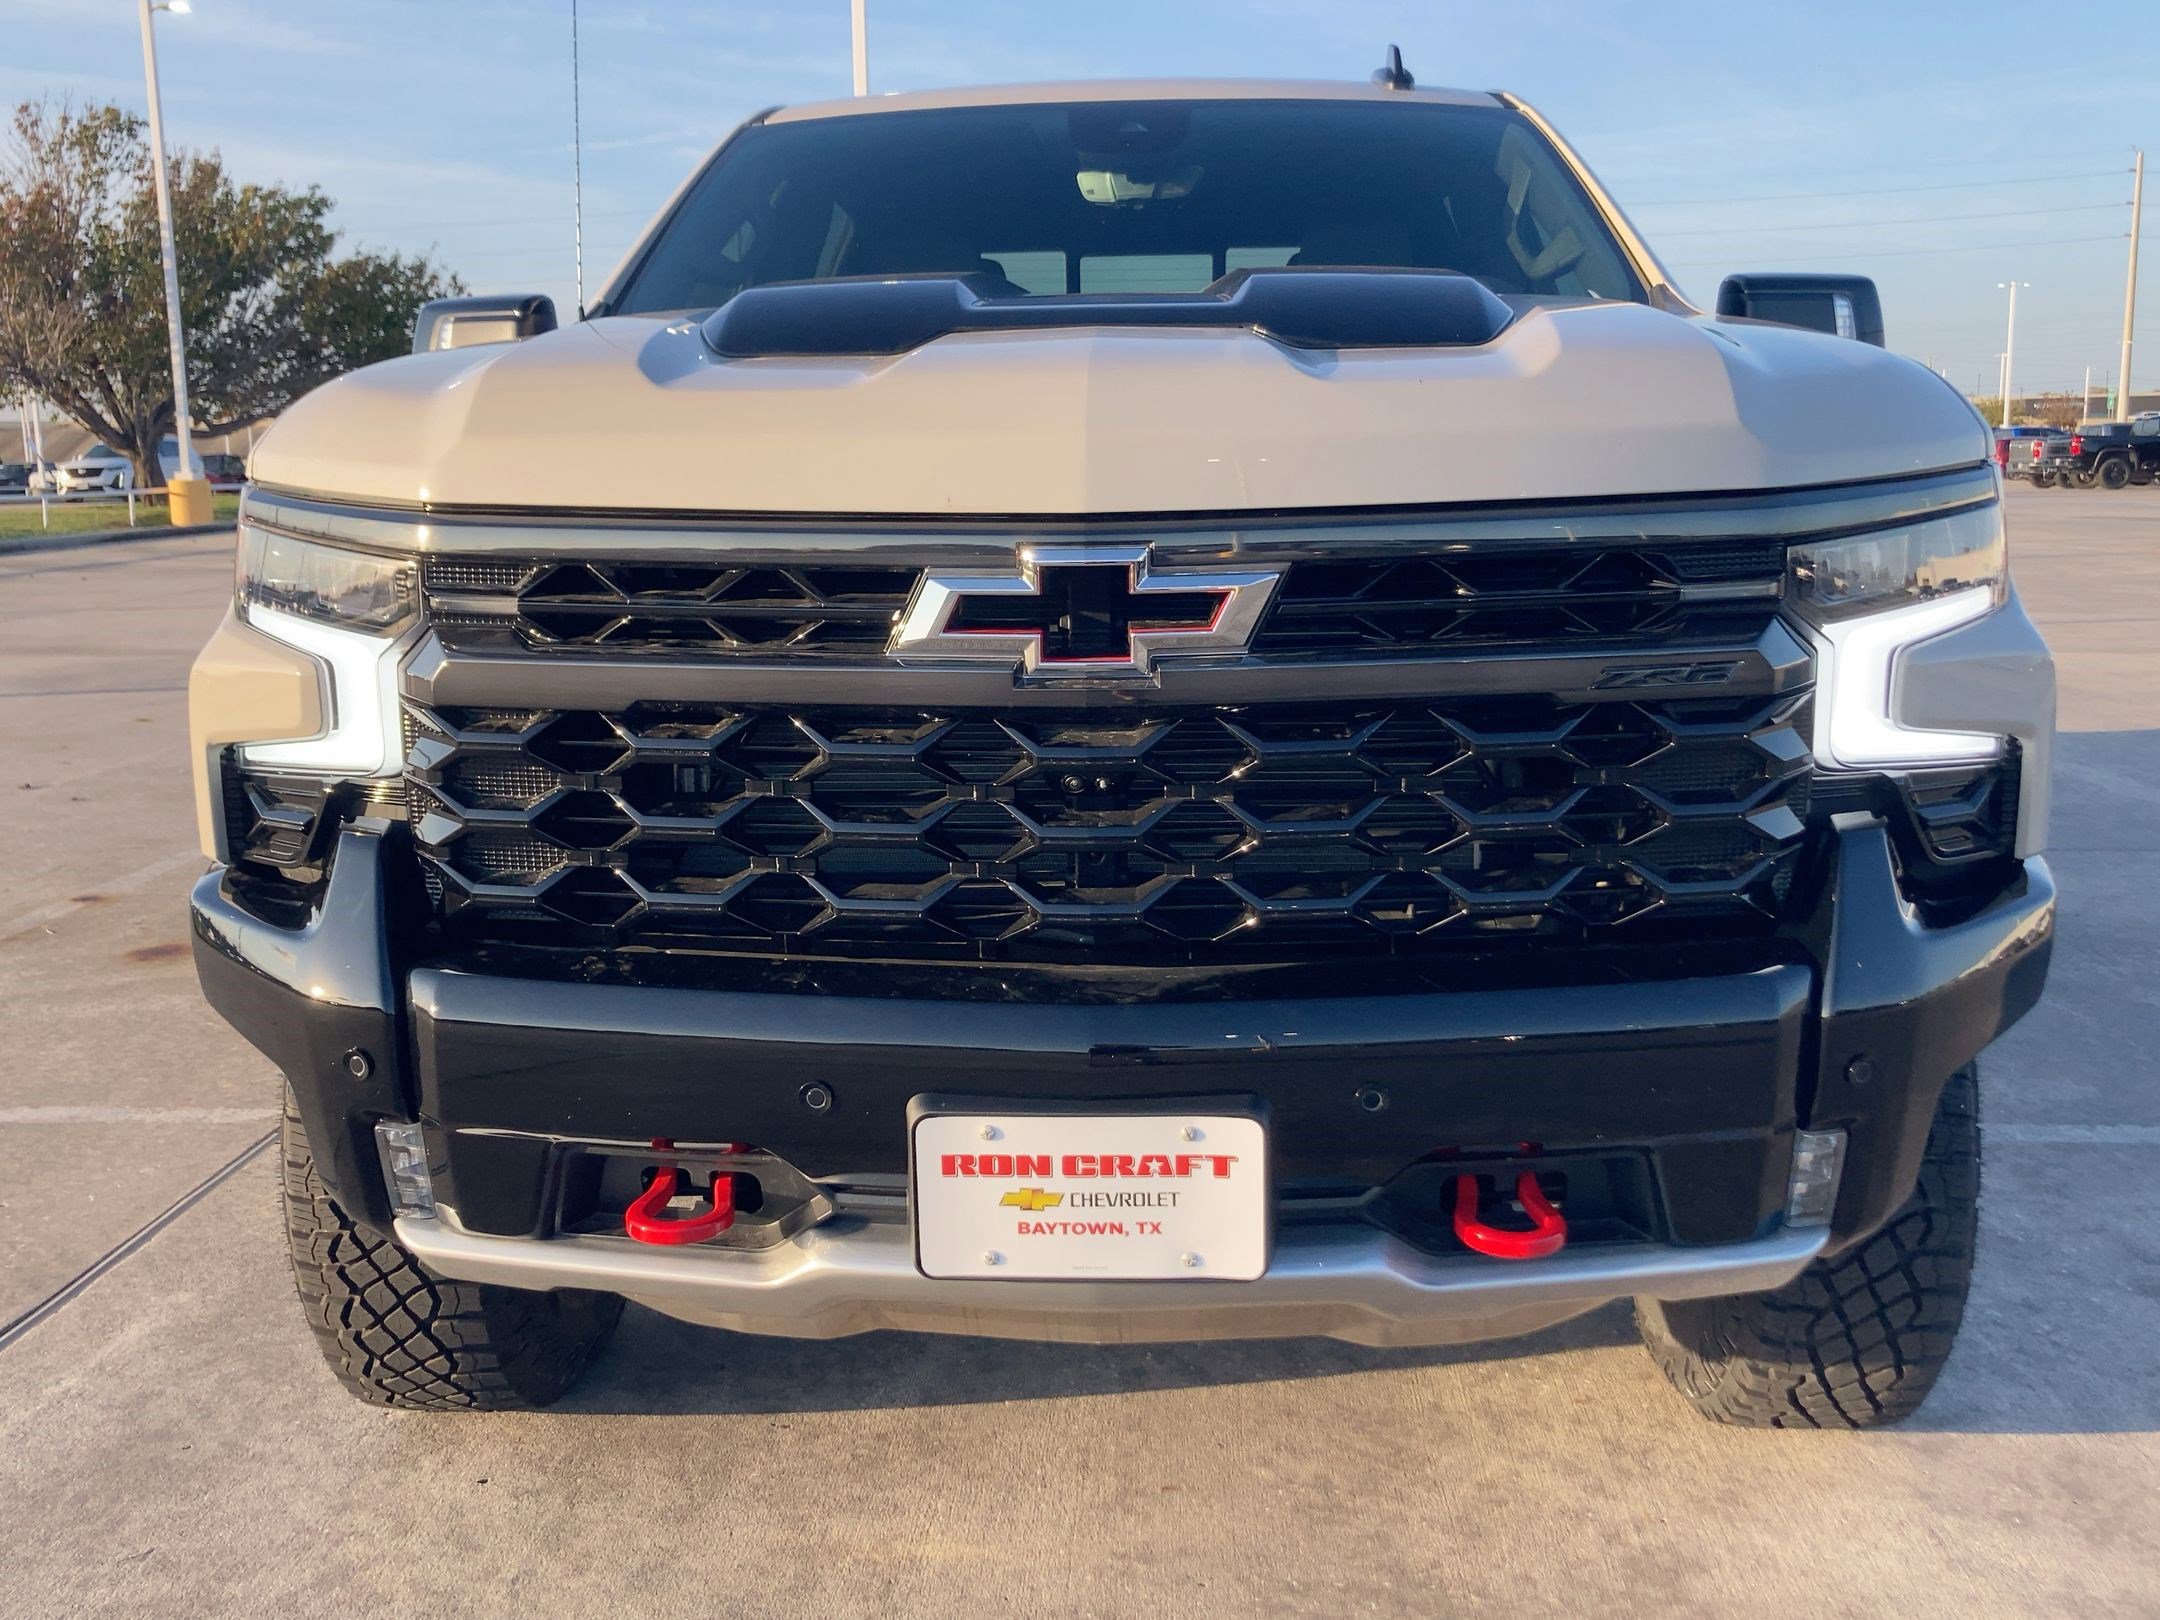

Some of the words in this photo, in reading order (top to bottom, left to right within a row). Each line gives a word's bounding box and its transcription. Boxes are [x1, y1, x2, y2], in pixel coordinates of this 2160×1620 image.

[941, 1153, 1054, 1178] RON
[1061, 1153, 1239, 1178] CRAFT
[1070, 1192, 1181, 1208] CHEVROLET
[1017, 1221, 1130, 1237] BAYTOWN,
[1137, 1221, 1162, 1235] TX
